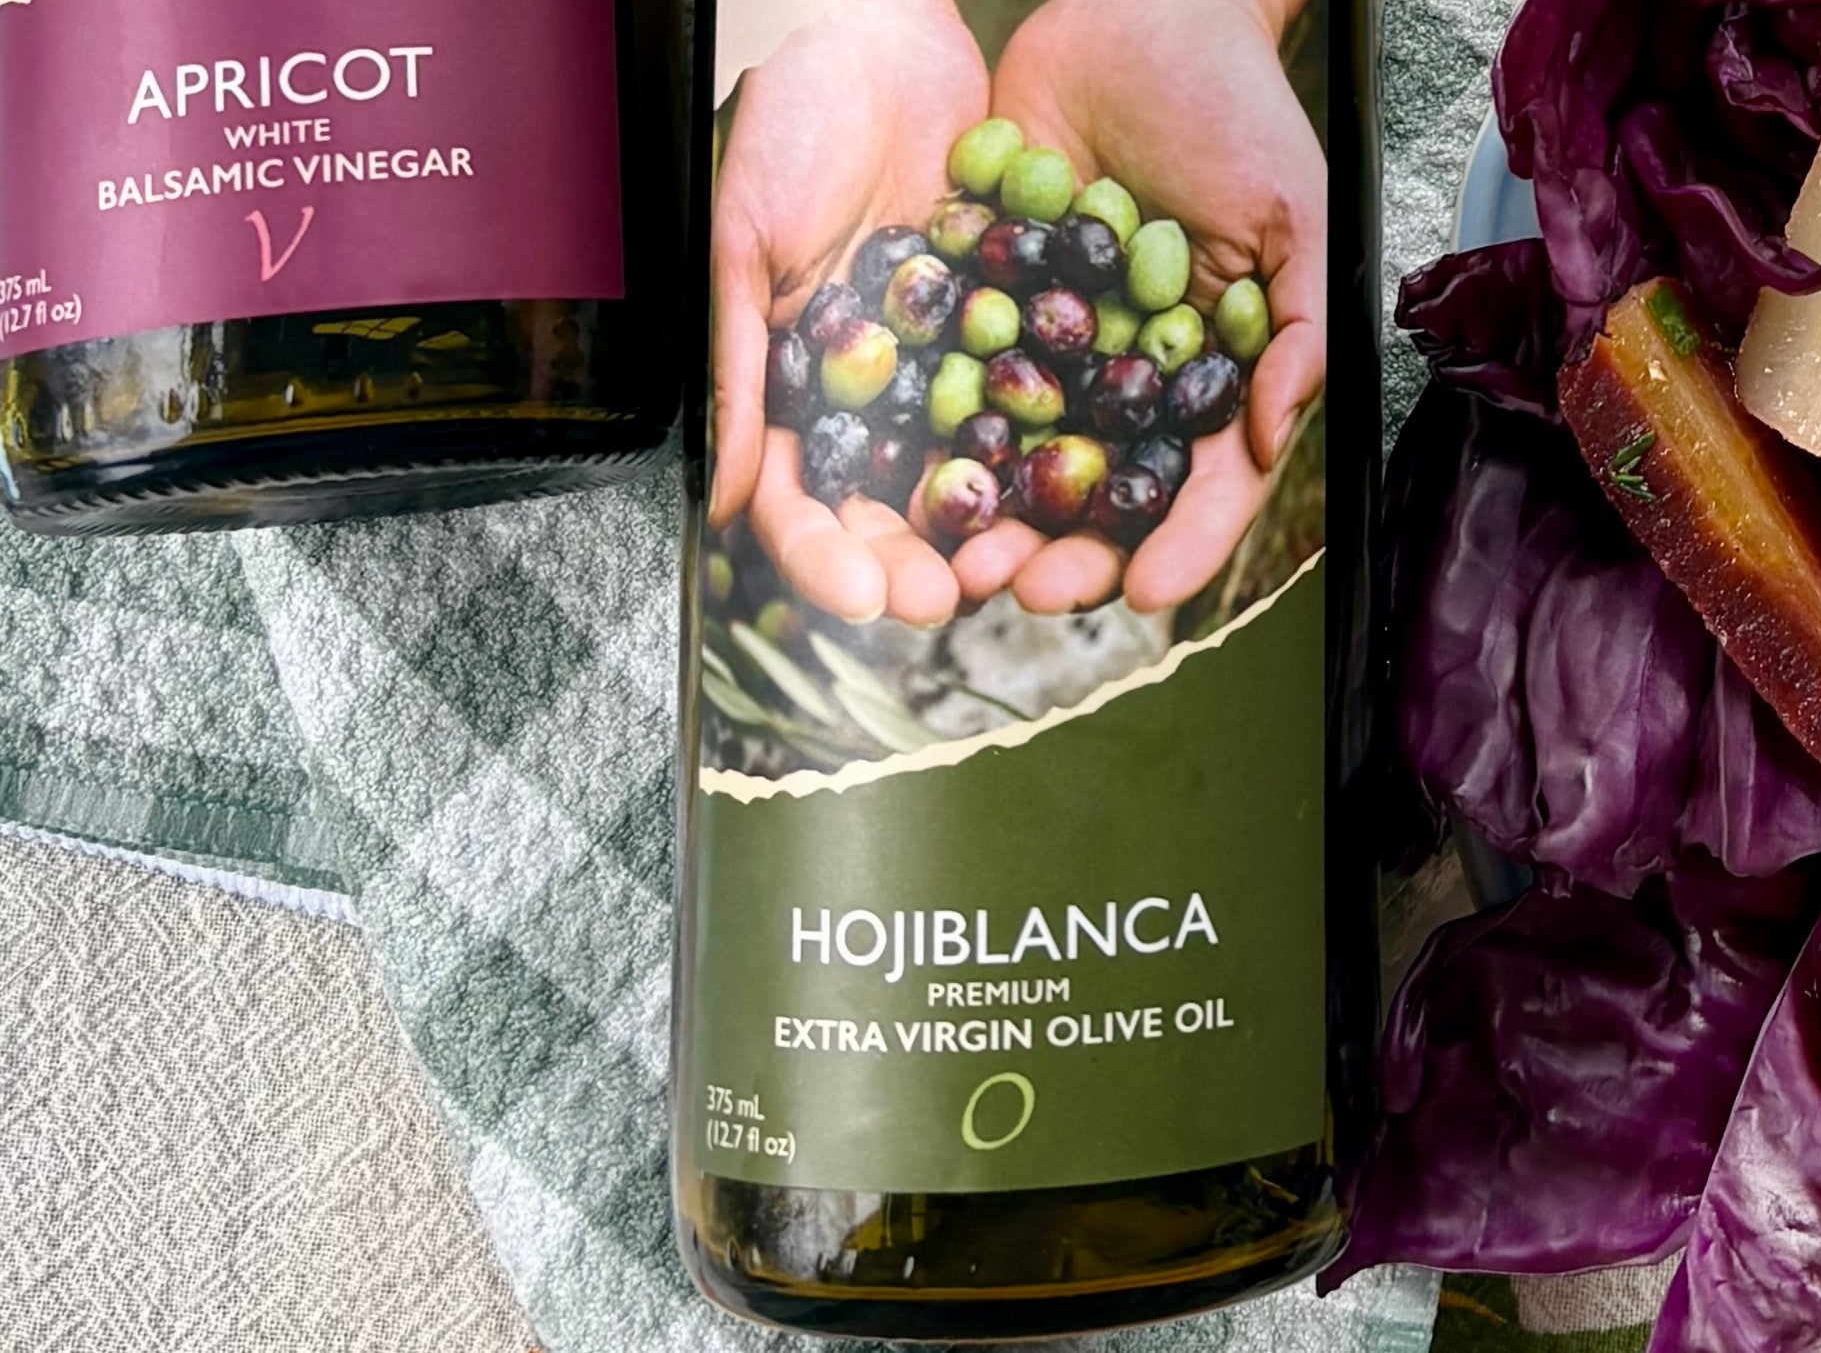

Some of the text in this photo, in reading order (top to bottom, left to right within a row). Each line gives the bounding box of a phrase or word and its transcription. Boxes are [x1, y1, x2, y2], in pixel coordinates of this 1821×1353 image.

[126, 46, 434, 125] APRICOT
[223, 118, 332, 151] WHITE
[97, 146, 475, 212] BALSAMIC VINEGAR
[25, 268, 52, 296] mL
[35, 300, 47, 326] fl
[50, 292, 82, 326] oz)
[791, 891, 1220, 984] HOJIBLANCA
[927, 977, 1071, 1008] PREMIUM
[774, 997, 1235, 1053] EXTRA VIRGIN OLIVE OIL
[706, 1084, 766, 1122] 375 mL
[747, 1126, 760, 1153] fl
[764, 1131, 796, 1165] oz)
